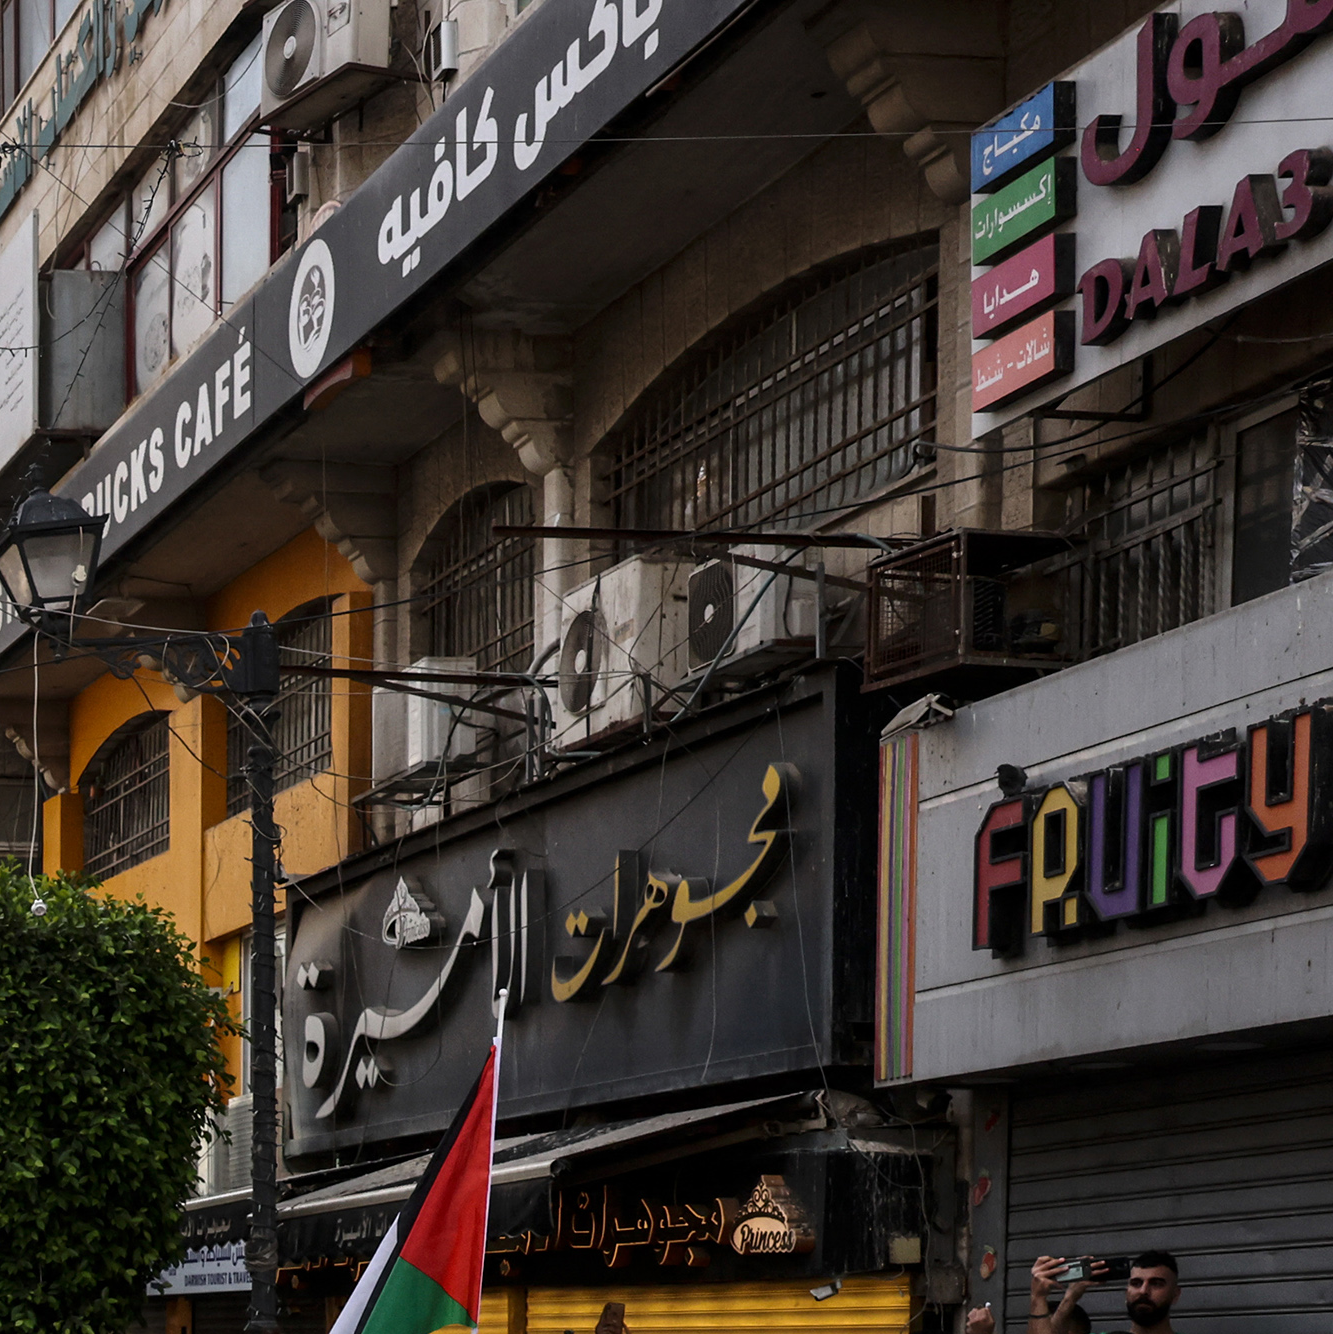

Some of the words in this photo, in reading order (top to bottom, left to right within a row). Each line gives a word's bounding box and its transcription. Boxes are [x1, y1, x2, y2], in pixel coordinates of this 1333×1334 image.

[983, 112, 1041, 176] مكياج
[378, 86, 498, 278] كافيه
[974, 173, 1052, 240] إكسسوارات
[983, 268, 1040, 320] هدايا
[975, 353, 1004, 393] شنط
[1016, 327, 1051, 370] شالات
[174, 326, 252, 469] CAFÉ
[296, 848, 533, 1121] الأميرة
[739, 1223, 797, 1254] Princess
